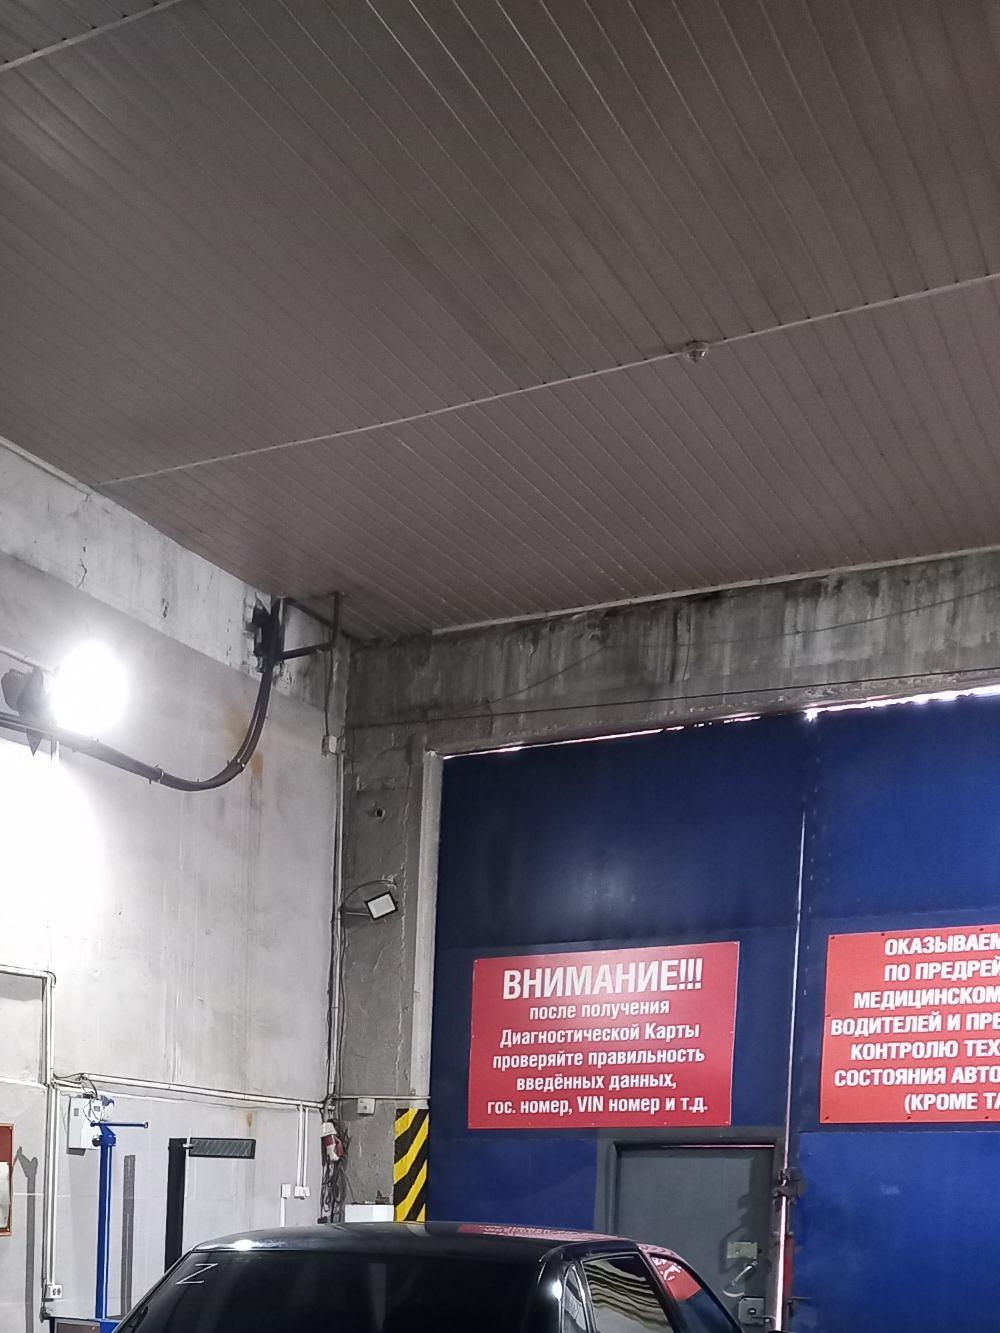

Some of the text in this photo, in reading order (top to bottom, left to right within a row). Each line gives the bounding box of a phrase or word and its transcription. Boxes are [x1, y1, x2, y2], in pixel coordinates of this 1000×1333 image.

[502, 957, 704, 1000] ВНИМАНИЕ!!!
[884, 963, 911, 982] ПО
[853, 985, 1000, 1010] МЕДИЦИНСКОМ
[529, 999, 670, 1020] после получения
[500, 1021, 700, 1048] Диагностической Карты
[830, 1011, 1000, 1037] ВОДИТЕЛЕЙ И ПРЕ
[493, 1048, 705, 1071] проверяйте правильность
[850, 1040, 959, 1061] КОНТРОЛЮ
[516, 1072, 677, 1092] введённых данных,
[833, 1065, 1000, 1087] СОСТОЯНИЯ АВТО
[487, 1095, 708, 1117] гос. номер, VIN номер и т.д.
[904, 1092, 978, 1115] (КРОМЕ
